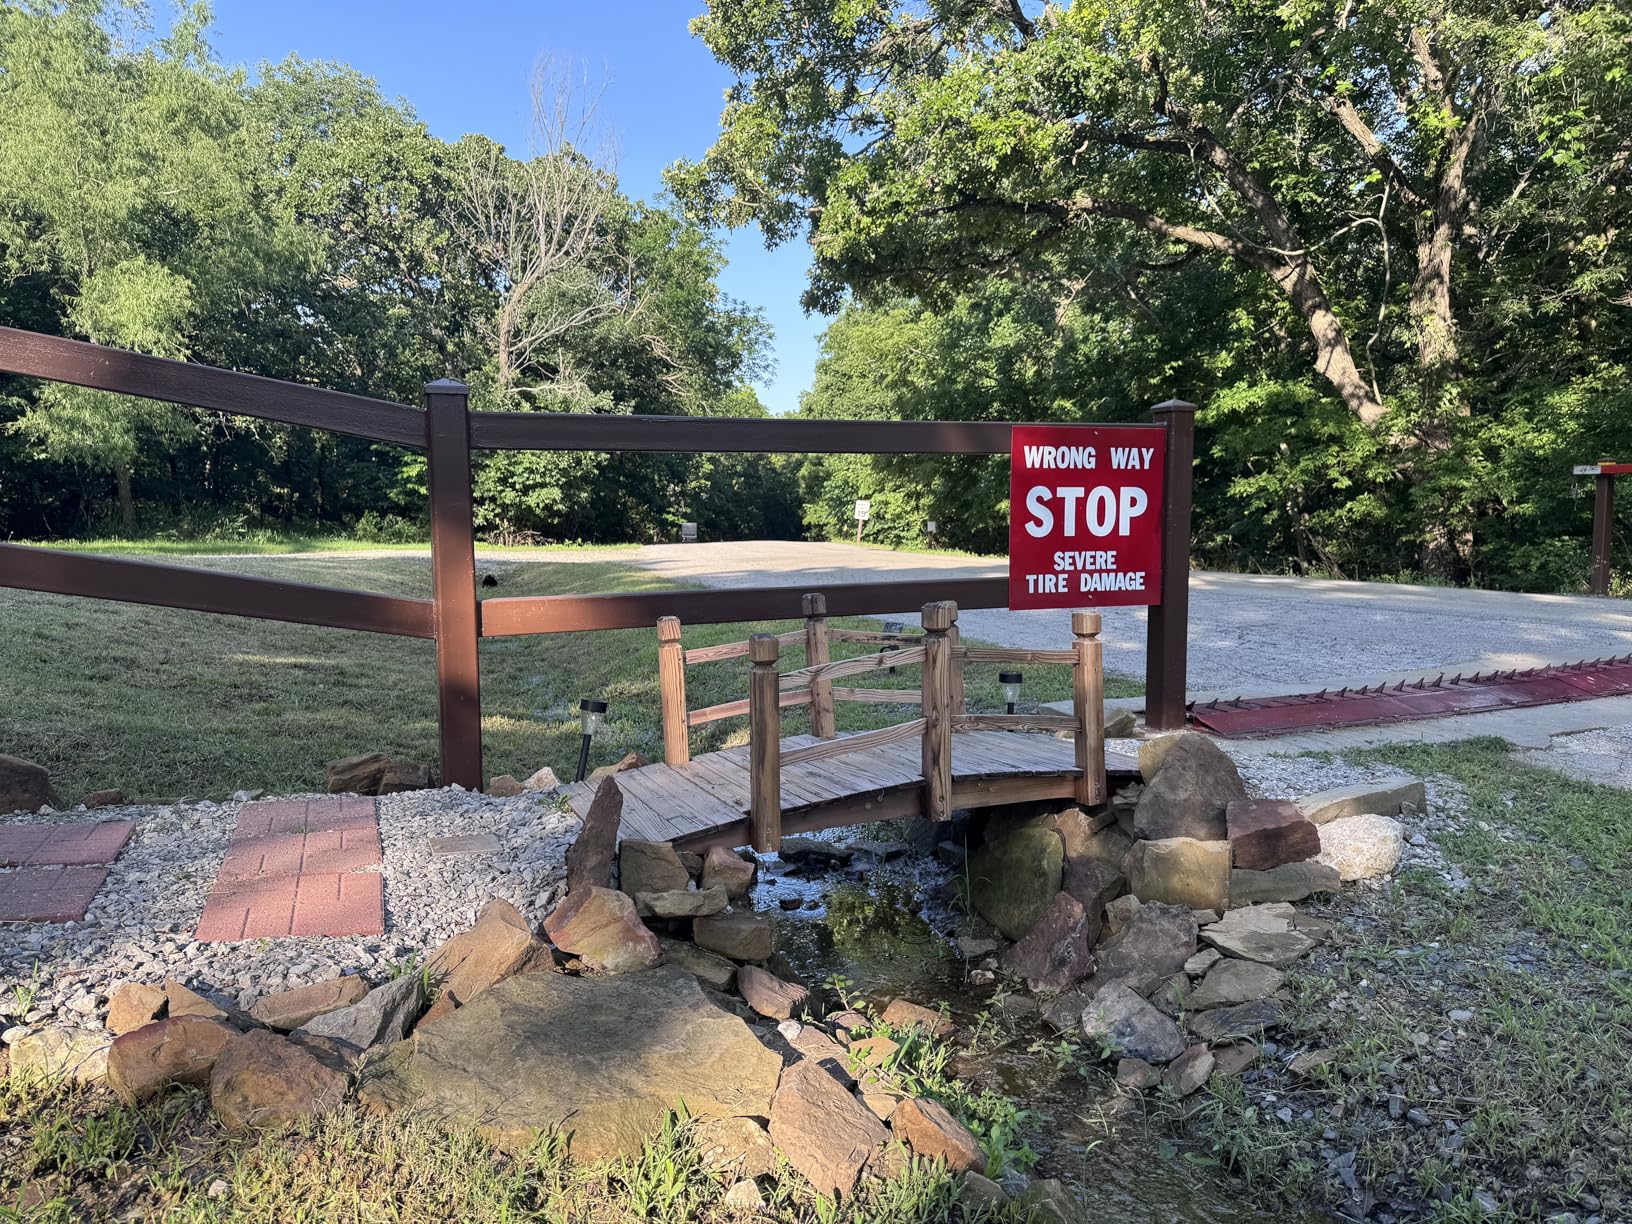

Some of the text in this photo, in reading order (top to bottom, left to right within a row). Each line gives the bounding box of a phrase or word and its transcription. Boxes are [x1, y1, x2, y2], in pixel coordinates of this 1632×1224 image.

[1023, 445, 1154, 470] WRONG WAY
[1024, 485, 1148, 538] STOP
[1053, 550, 1117, 571] SEVERE
[1026, 571, 1146, 593] TIRE DAMAGE
